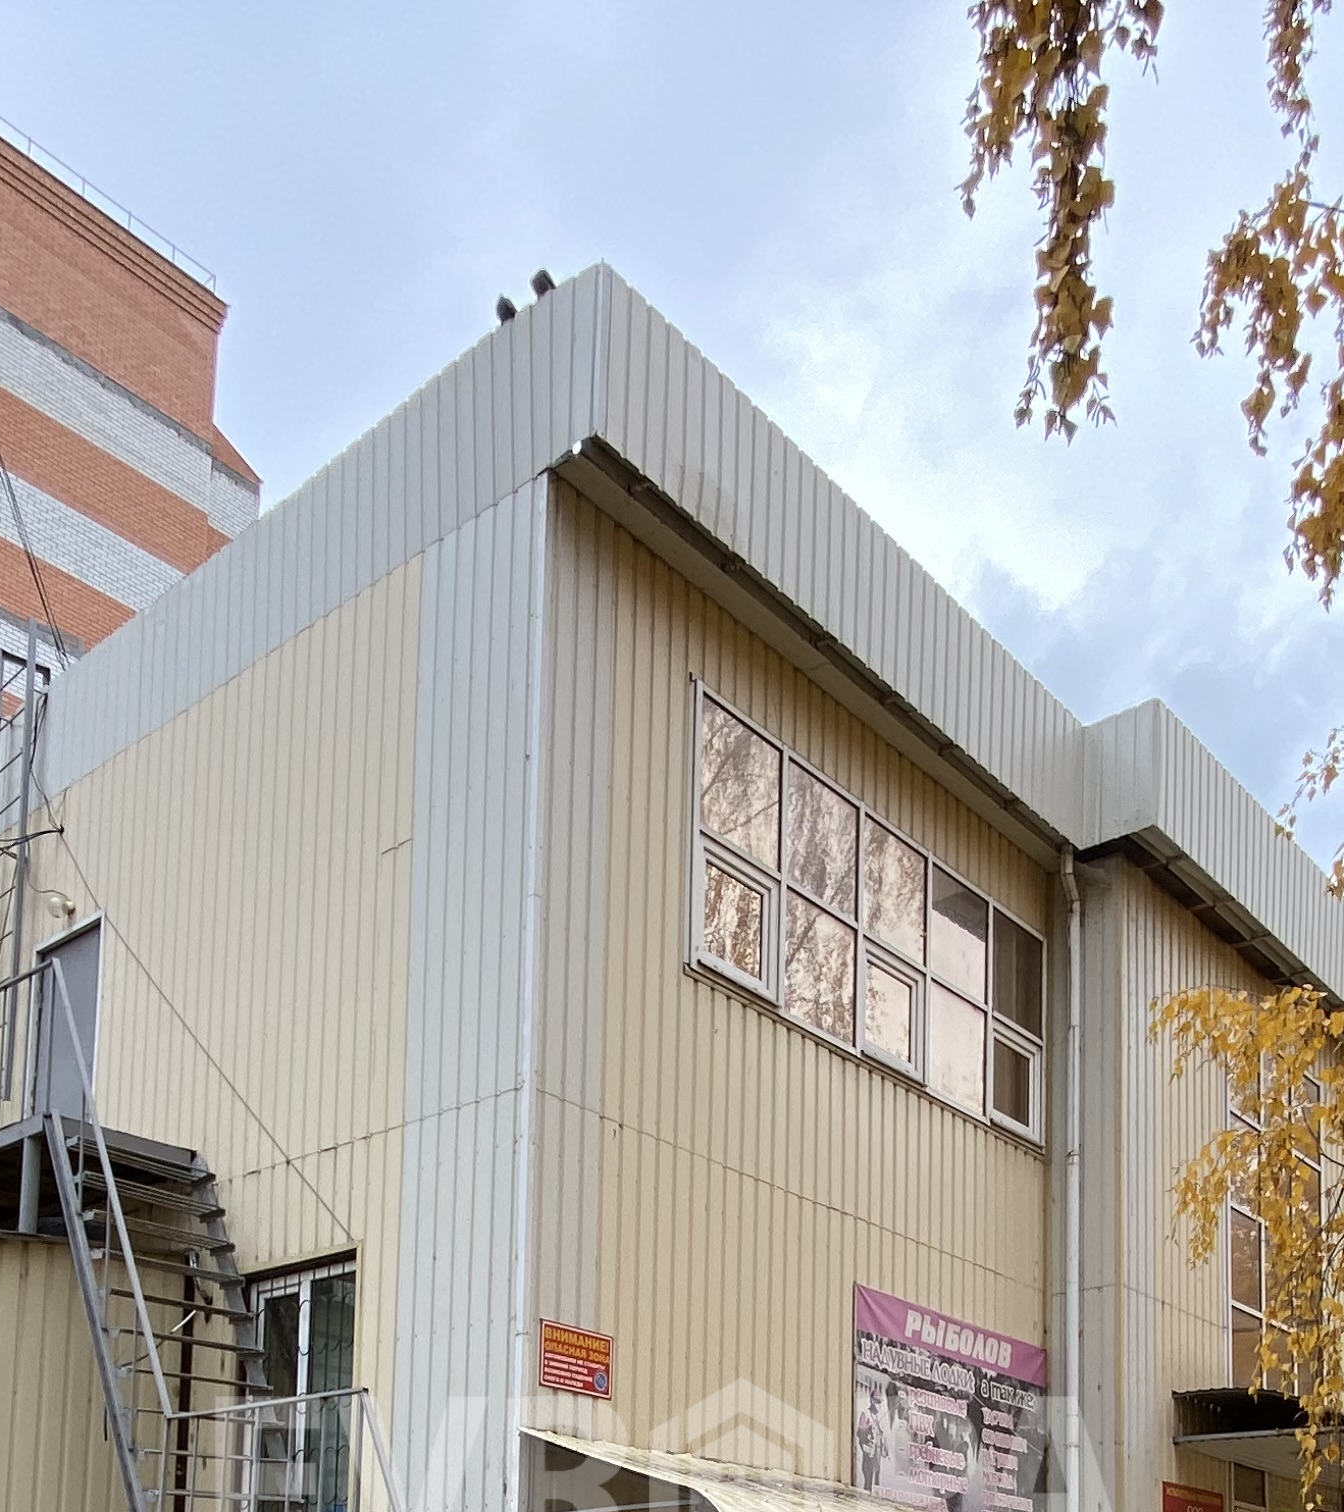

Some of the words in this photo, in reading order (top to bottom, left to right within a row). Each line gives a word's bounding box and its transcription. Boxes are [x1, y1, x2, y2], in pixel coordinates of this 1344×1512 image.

[544, 1340, 587, 1359] ОПАСНАЯ
[588, 1350, 610, 1363] ЗОНА
[904, 1308, 1012, 1369] РЫБОЛОВ
[861, 1339, 931, 1379] НАДУВНЫЕ
[908, 1410, 935, 1437] ПВХ
